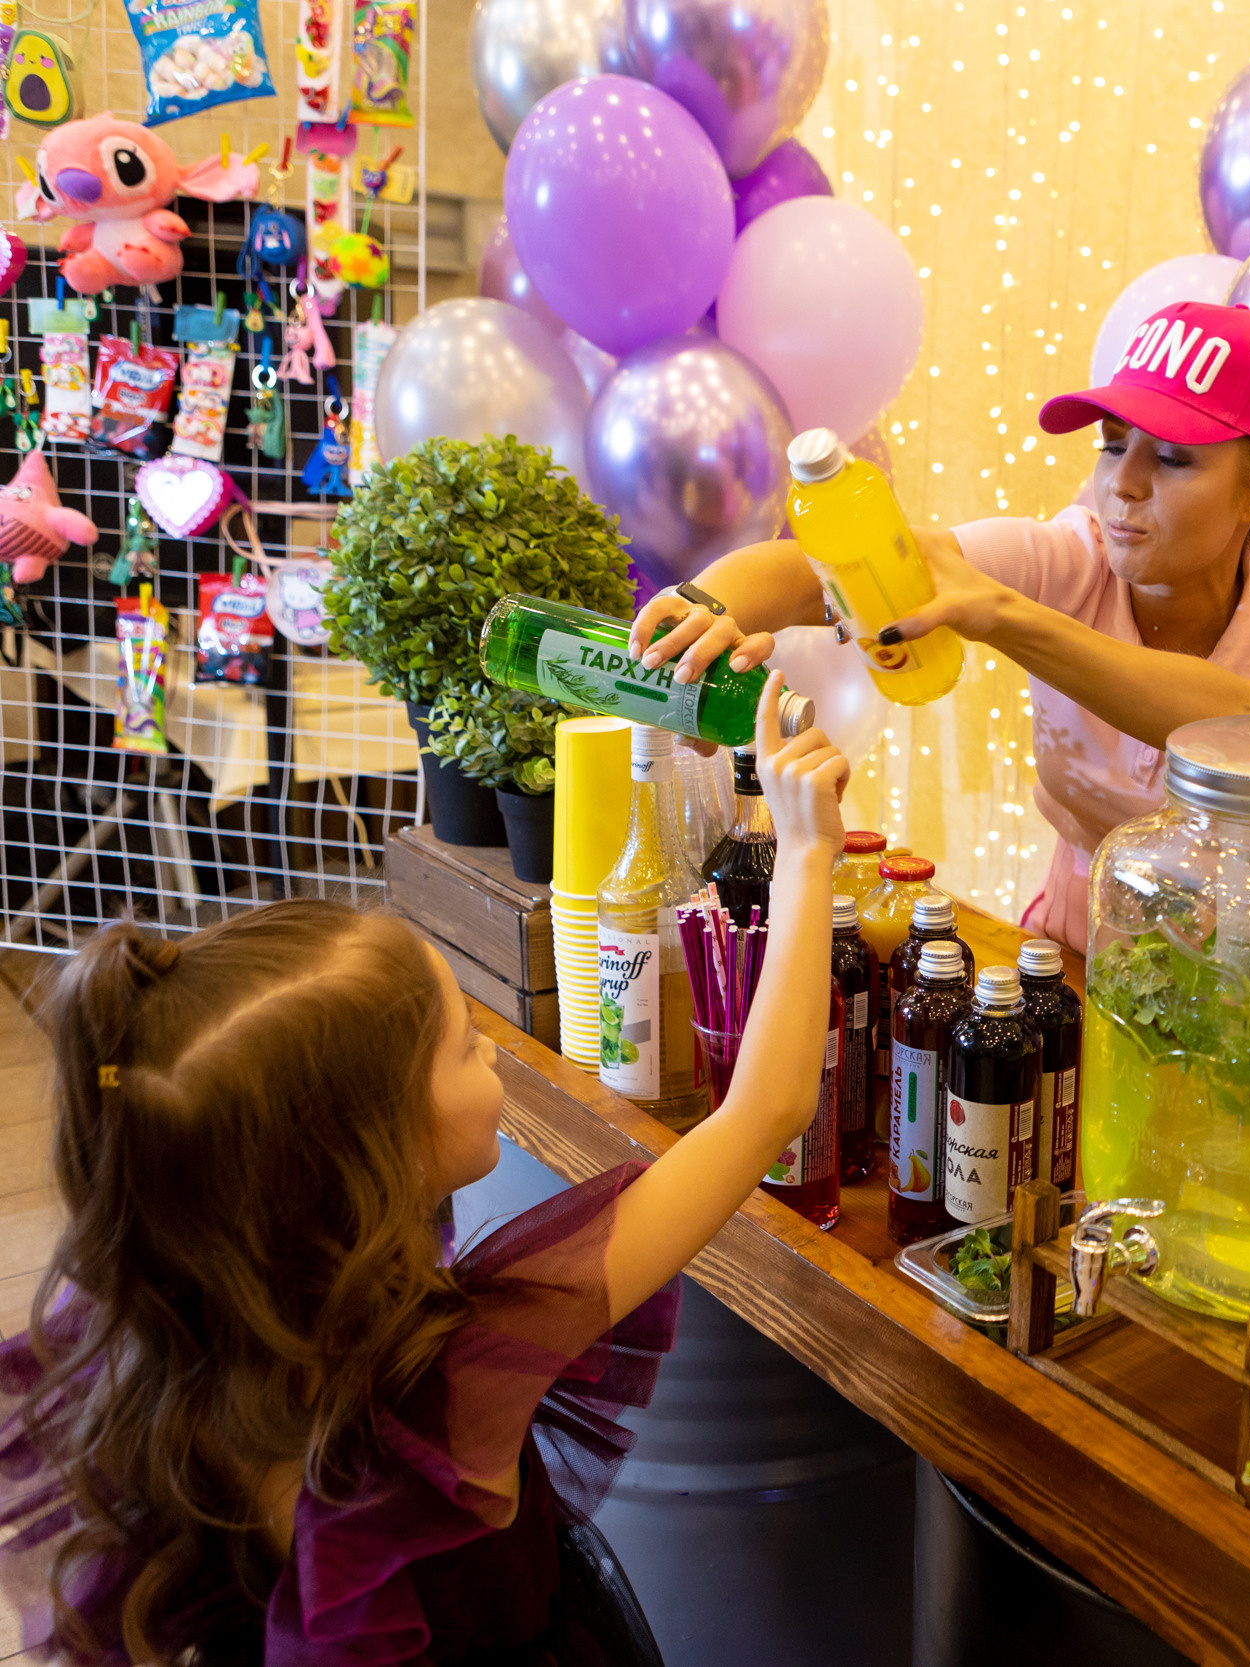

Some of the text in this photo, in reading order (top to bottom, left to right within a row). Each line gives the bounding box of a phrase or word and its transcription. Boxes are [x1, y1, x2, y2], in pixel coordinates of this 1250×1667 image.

[580, 645, 674, 689] ТАРХУН
[600, 977, 629, 999] yrup
[892, 1066, 902, 1159] КАРАМЕЛЬ
[947, 1156, 982, 1185] ОЛА
